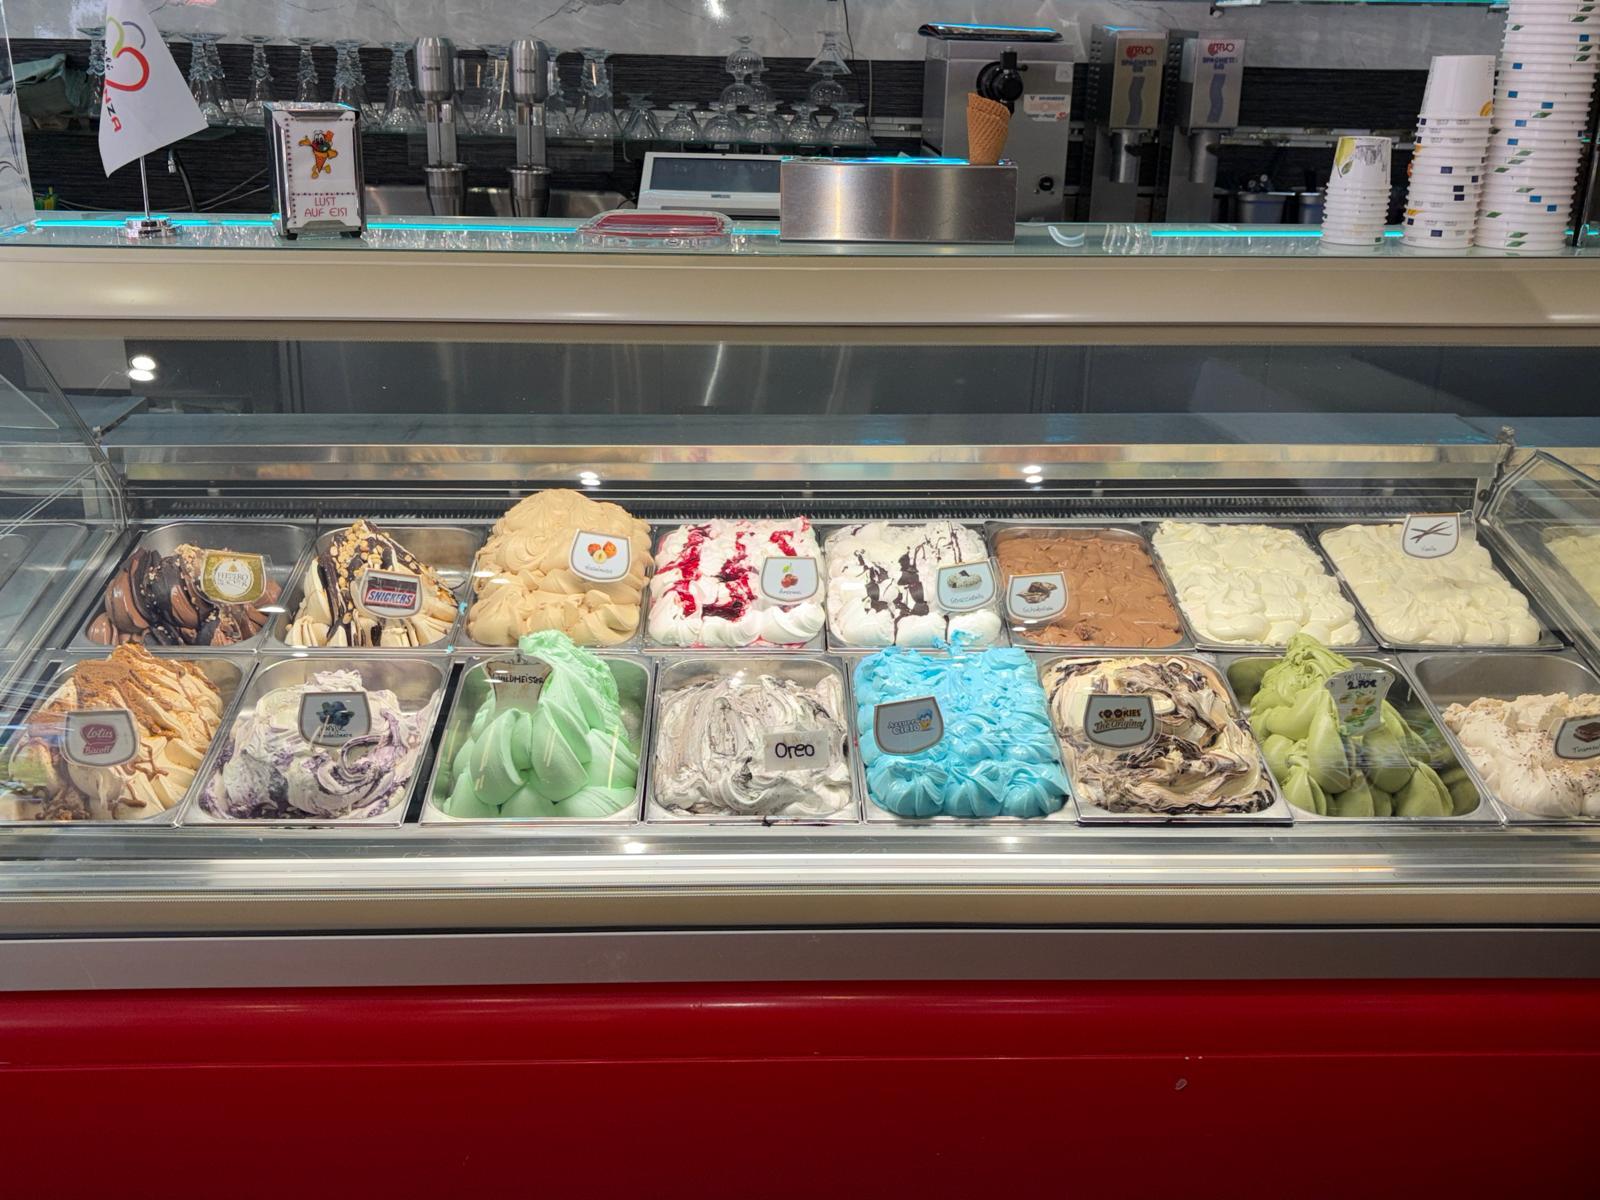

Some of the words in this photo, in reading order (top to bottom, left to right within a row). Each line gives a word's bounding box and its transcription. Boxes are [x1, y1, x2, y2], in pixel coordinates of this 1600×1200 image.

[314, 197, 336, 207] LUST
[304, 208, 325, 217] AUF
[368, 590, 414, 605] SNICKERS
[1347, 679, 1377, 690] 2.70€
[1098, 708, 1142, 719] COOKIES
[1094, 721, 1110, 731] The
[1110, 718, 1146, 731] Original
[87, 726, 113, 739] Lotus
[84, 744, 112, 754] Biscoff
[775, 742, 815, 759] Oreo
